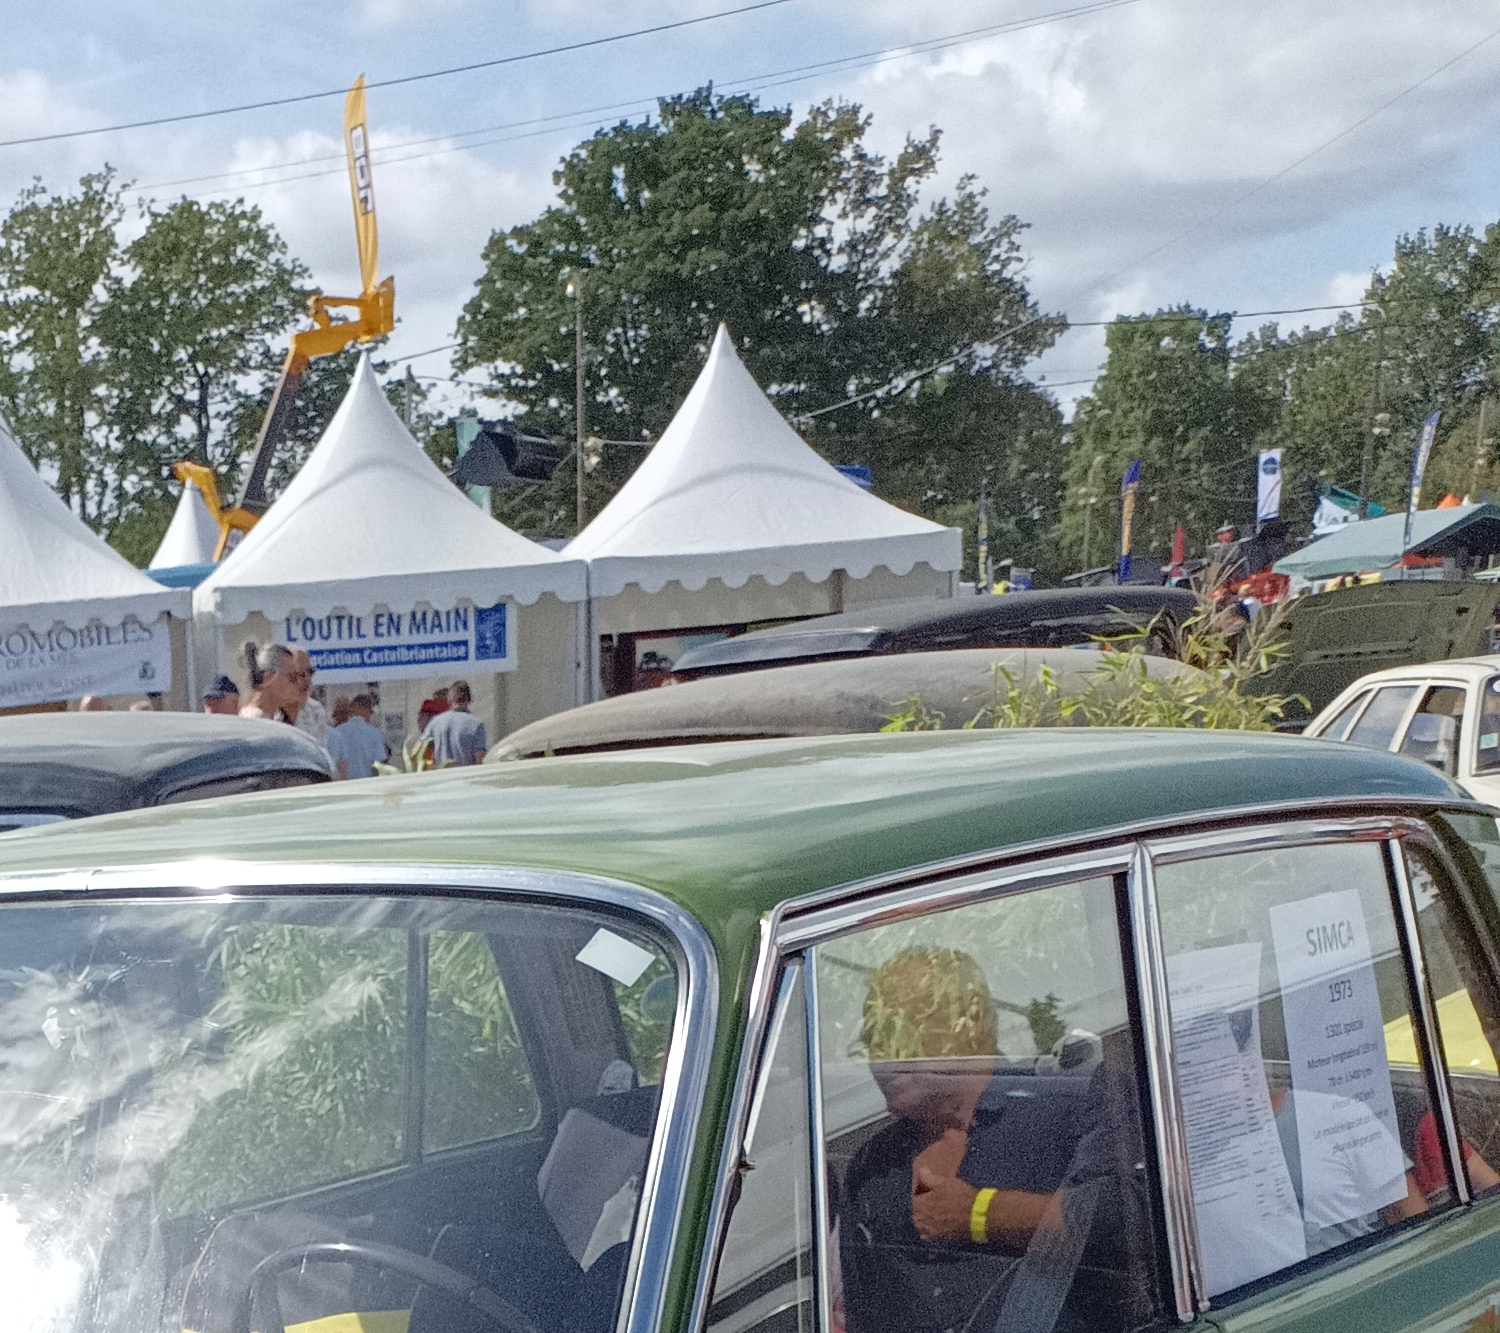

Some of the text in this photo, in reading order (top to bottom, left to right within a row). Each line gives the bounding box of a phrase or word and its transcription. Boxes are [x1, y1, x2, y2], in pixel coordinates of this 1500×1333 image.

[285, 606, 469, 642] L'OUTIL EN MAIN
[1305, 919, 1356, 957] SIMCA
[1328, 979, 1354, 1003] 1973
